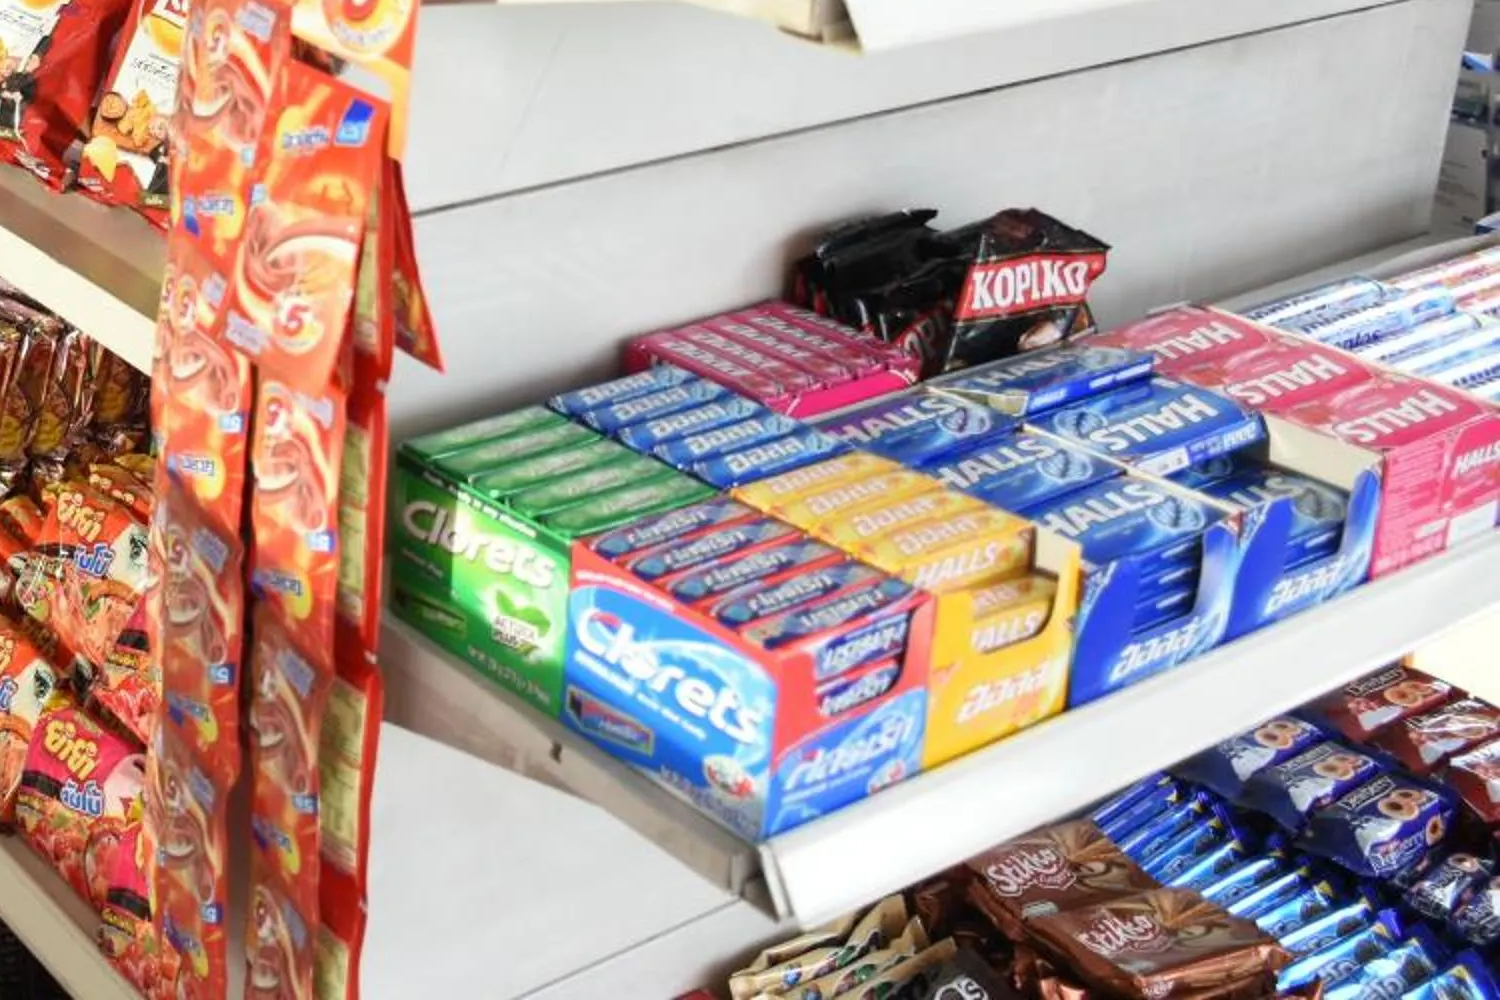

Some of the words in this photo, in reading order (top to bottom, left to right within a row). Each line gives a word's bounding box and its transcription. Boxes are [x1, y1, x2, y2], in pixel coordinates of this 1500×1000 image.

[971, 259, 1089, 311] KOPIKO
[975, 351, 1076, 387] HALL
[1151, 321, 1243, 365] HALL
[1225, 353, 1347, 405] HALLS
[826, 397, 957, 444] HALLS
[1089, 393, 1219, 451] HALLS
[1333, 389, 1459, 443] HALLS
[403, 501, 555, 588] Clorets
[913, 542, 999, 588] HALLS
[578, 607, 765, 744] Clorets
